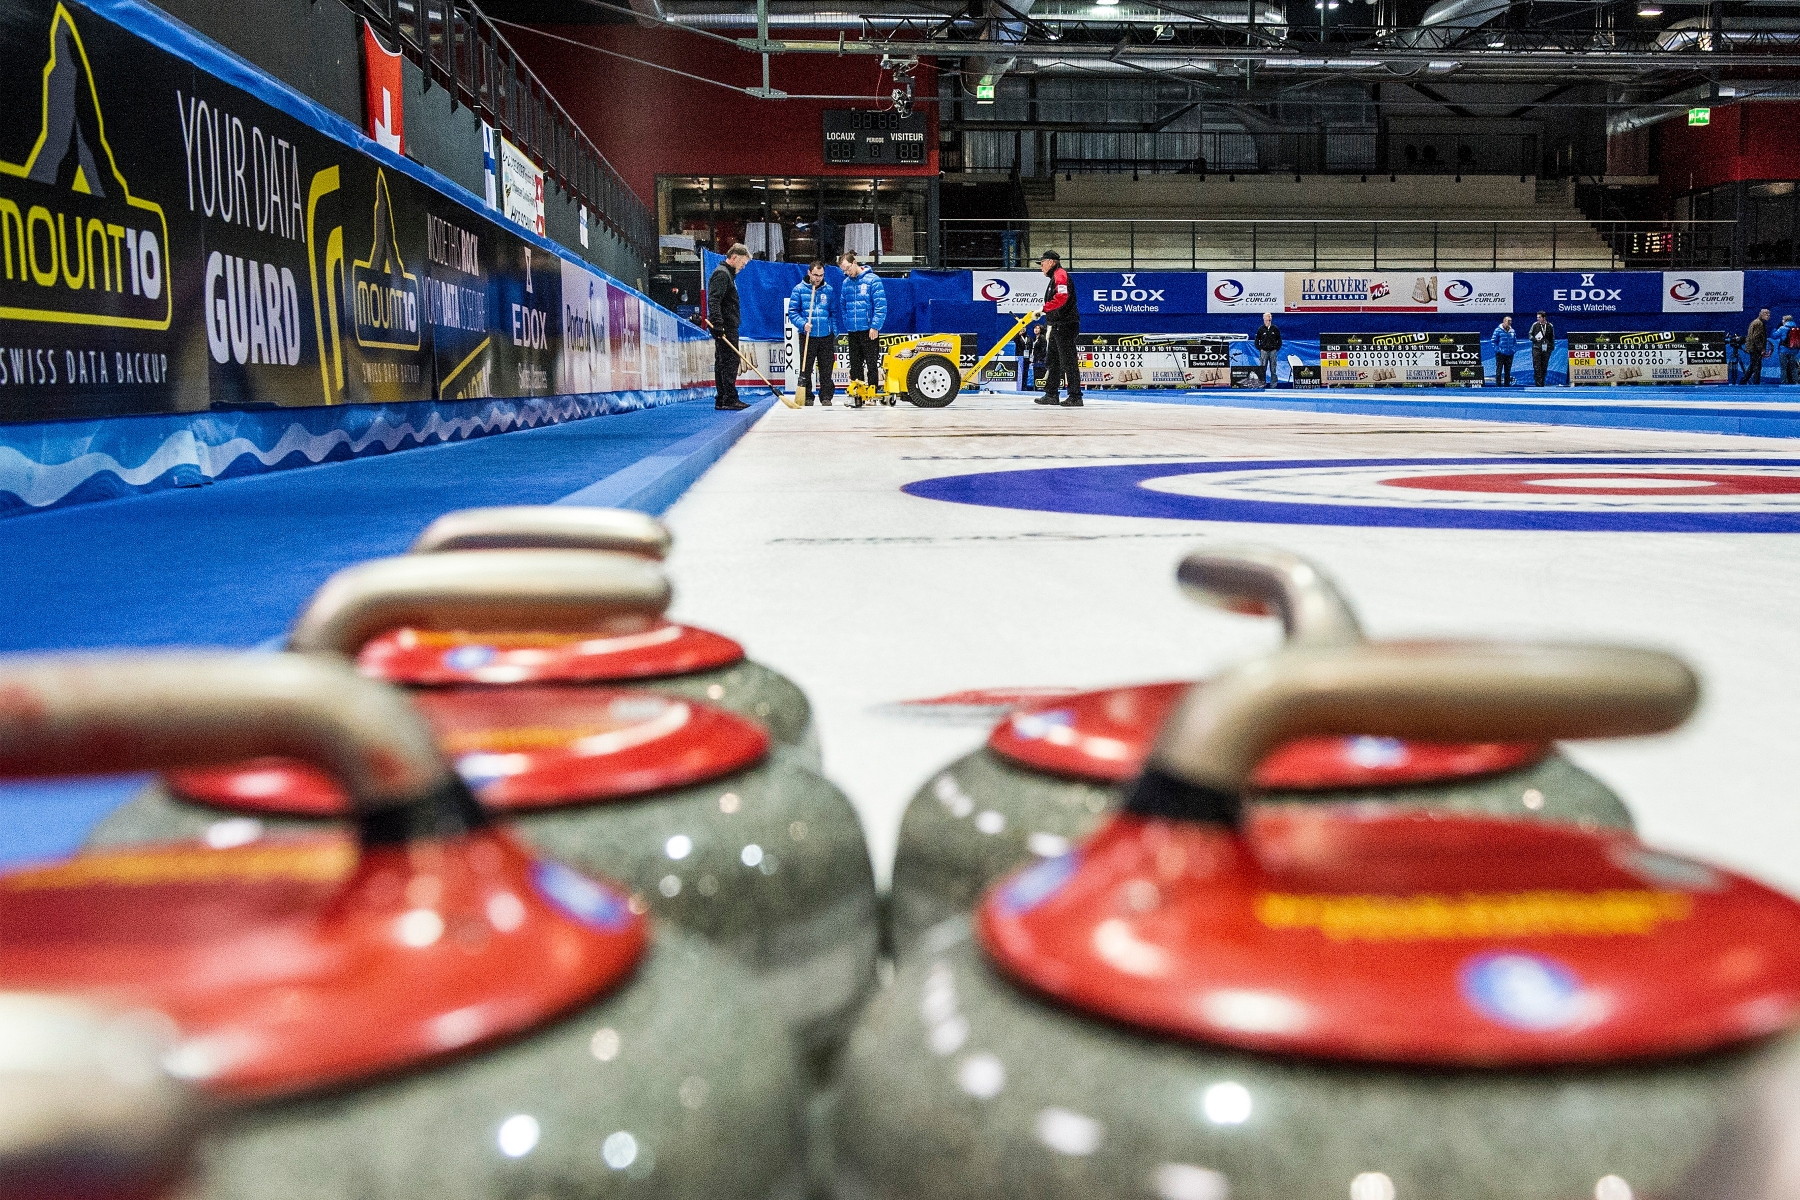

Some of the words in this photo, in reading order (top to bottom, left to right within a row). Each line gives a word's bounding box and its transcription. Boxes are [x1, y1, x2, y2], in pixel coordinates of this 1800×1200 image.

[826, 132, 856, 140] LOCAUX
[890, 132, 924, 141] VISITEUR
[177, 90, 250, 228] YOUR
[252, 126, 306, 243] DATA
[427, 213, 448, 266] INSIDE
[461, 228, 479, 276] ROCK
[1302, 279, 1314, 292] LE
[1318, 277, 1368, 292] GRUYÈRE
[422, 275, 442, 325] YOUR
[442, 281, 460, 328] DATA
[1093, 290, 1165, 301] EDOX
[1553, 289, 1622, 300] EDOX
[205, 250, 301, 366] GUARD
[358, 280, 417, 333] MOUNT10
[1099, 304, 1122, 312] Swiss
[1124, 304, 1159, 312] Watches
[511, 303, 548, 350] EDOX
[879, 334, 919, 347] OUNT10
[1376, 333, 1425, 345] MOUNT10
[1624, 332, 1671, 344] MOUNT10
[66, 350, 109, 384] DATA
[116, 351, 168, 384] BACKUP
